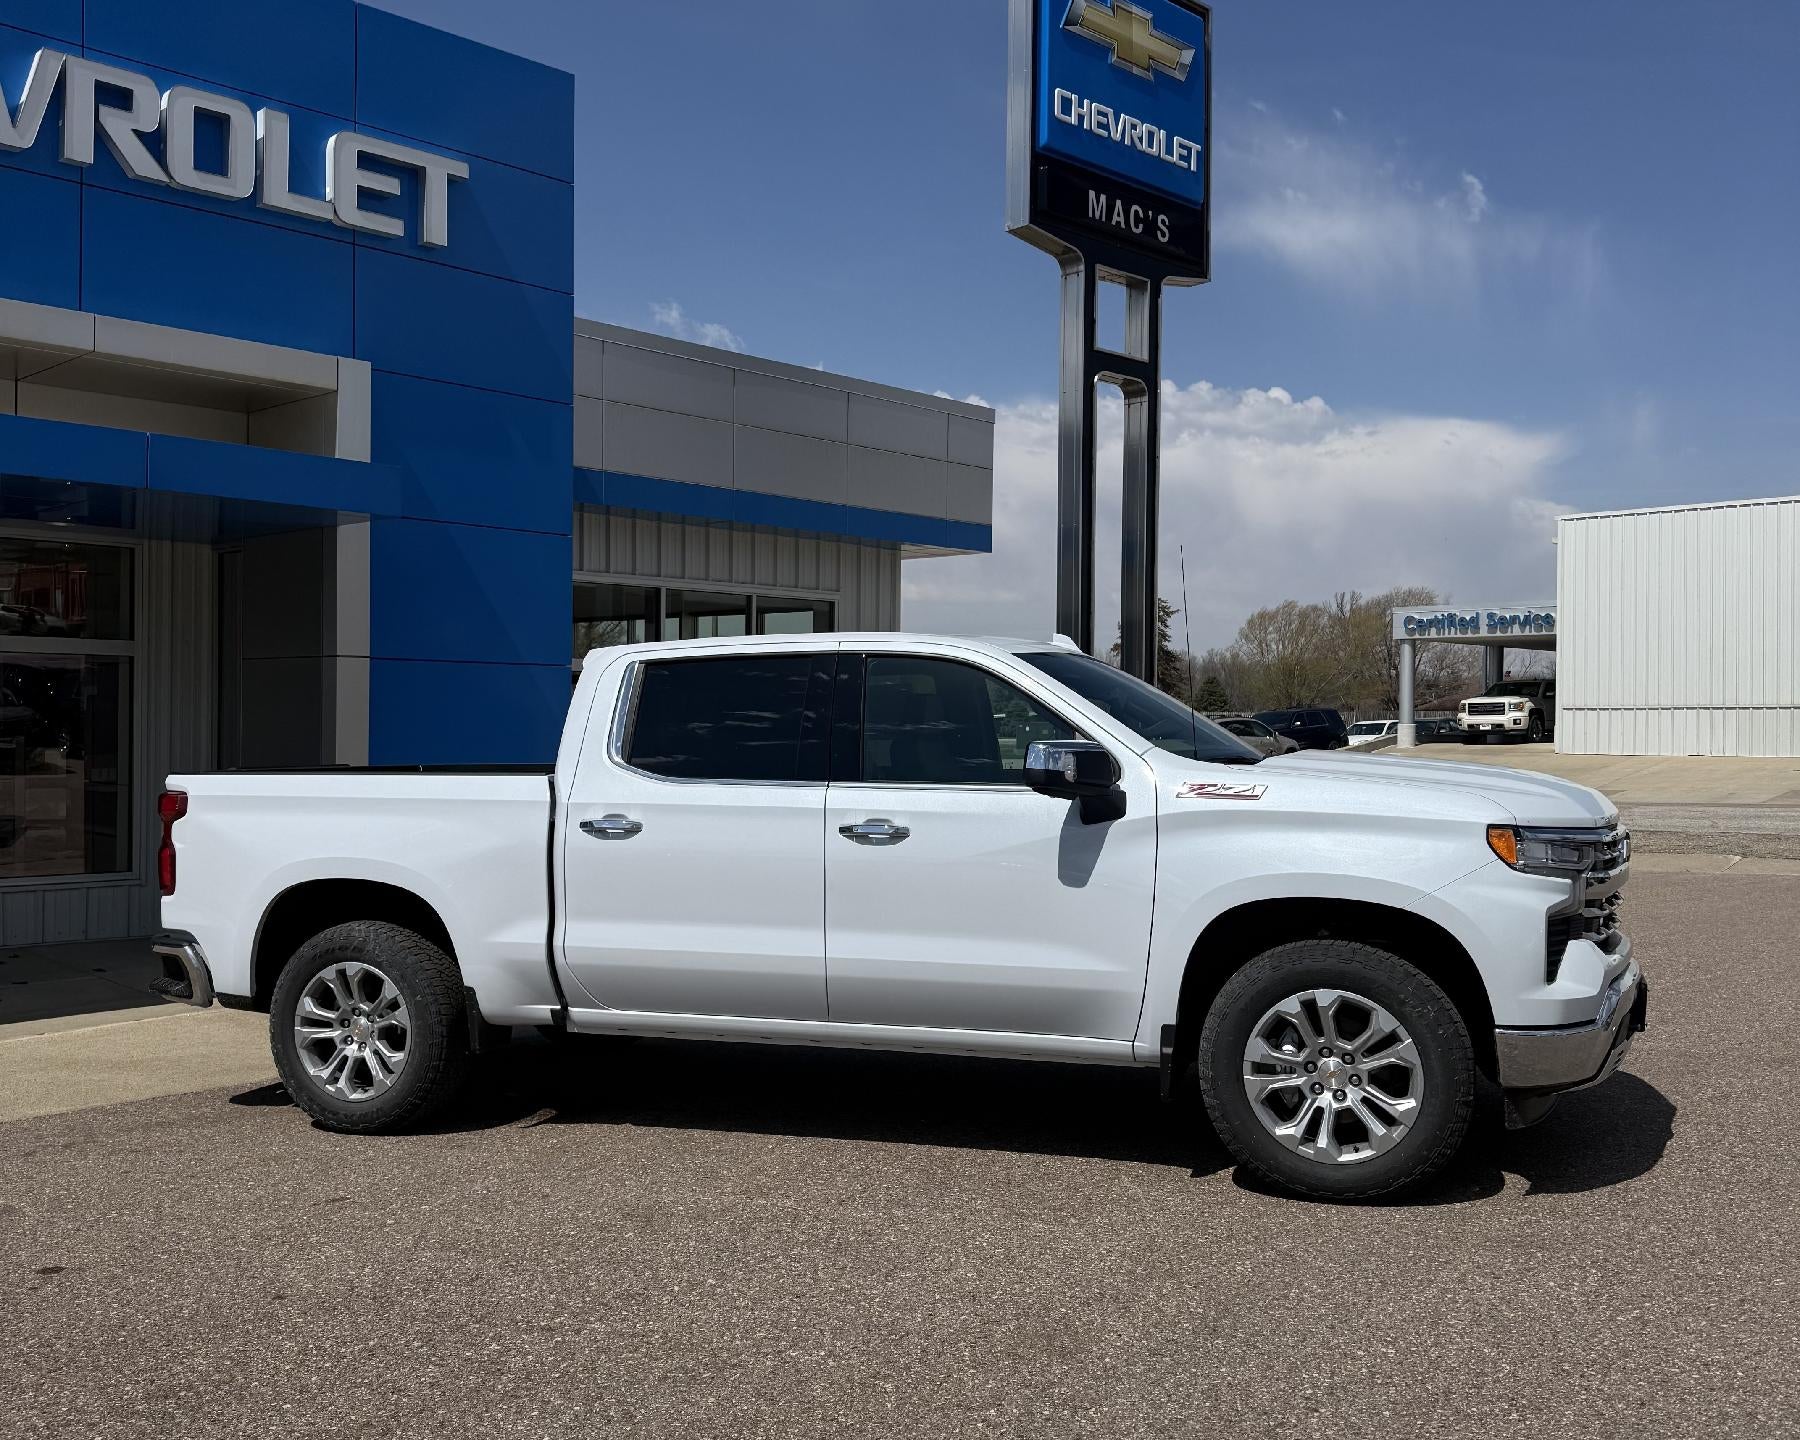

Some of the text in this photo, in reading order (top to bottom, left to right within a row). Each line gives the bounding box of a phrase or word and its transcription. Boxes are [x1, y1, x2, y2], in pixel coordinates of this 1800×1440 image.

[1055, 88, 1202, 172] CHEVROLET
[1088, 189, 1170, 243] MAC'S
[1403, 611, 1555, 633] Certified Service
